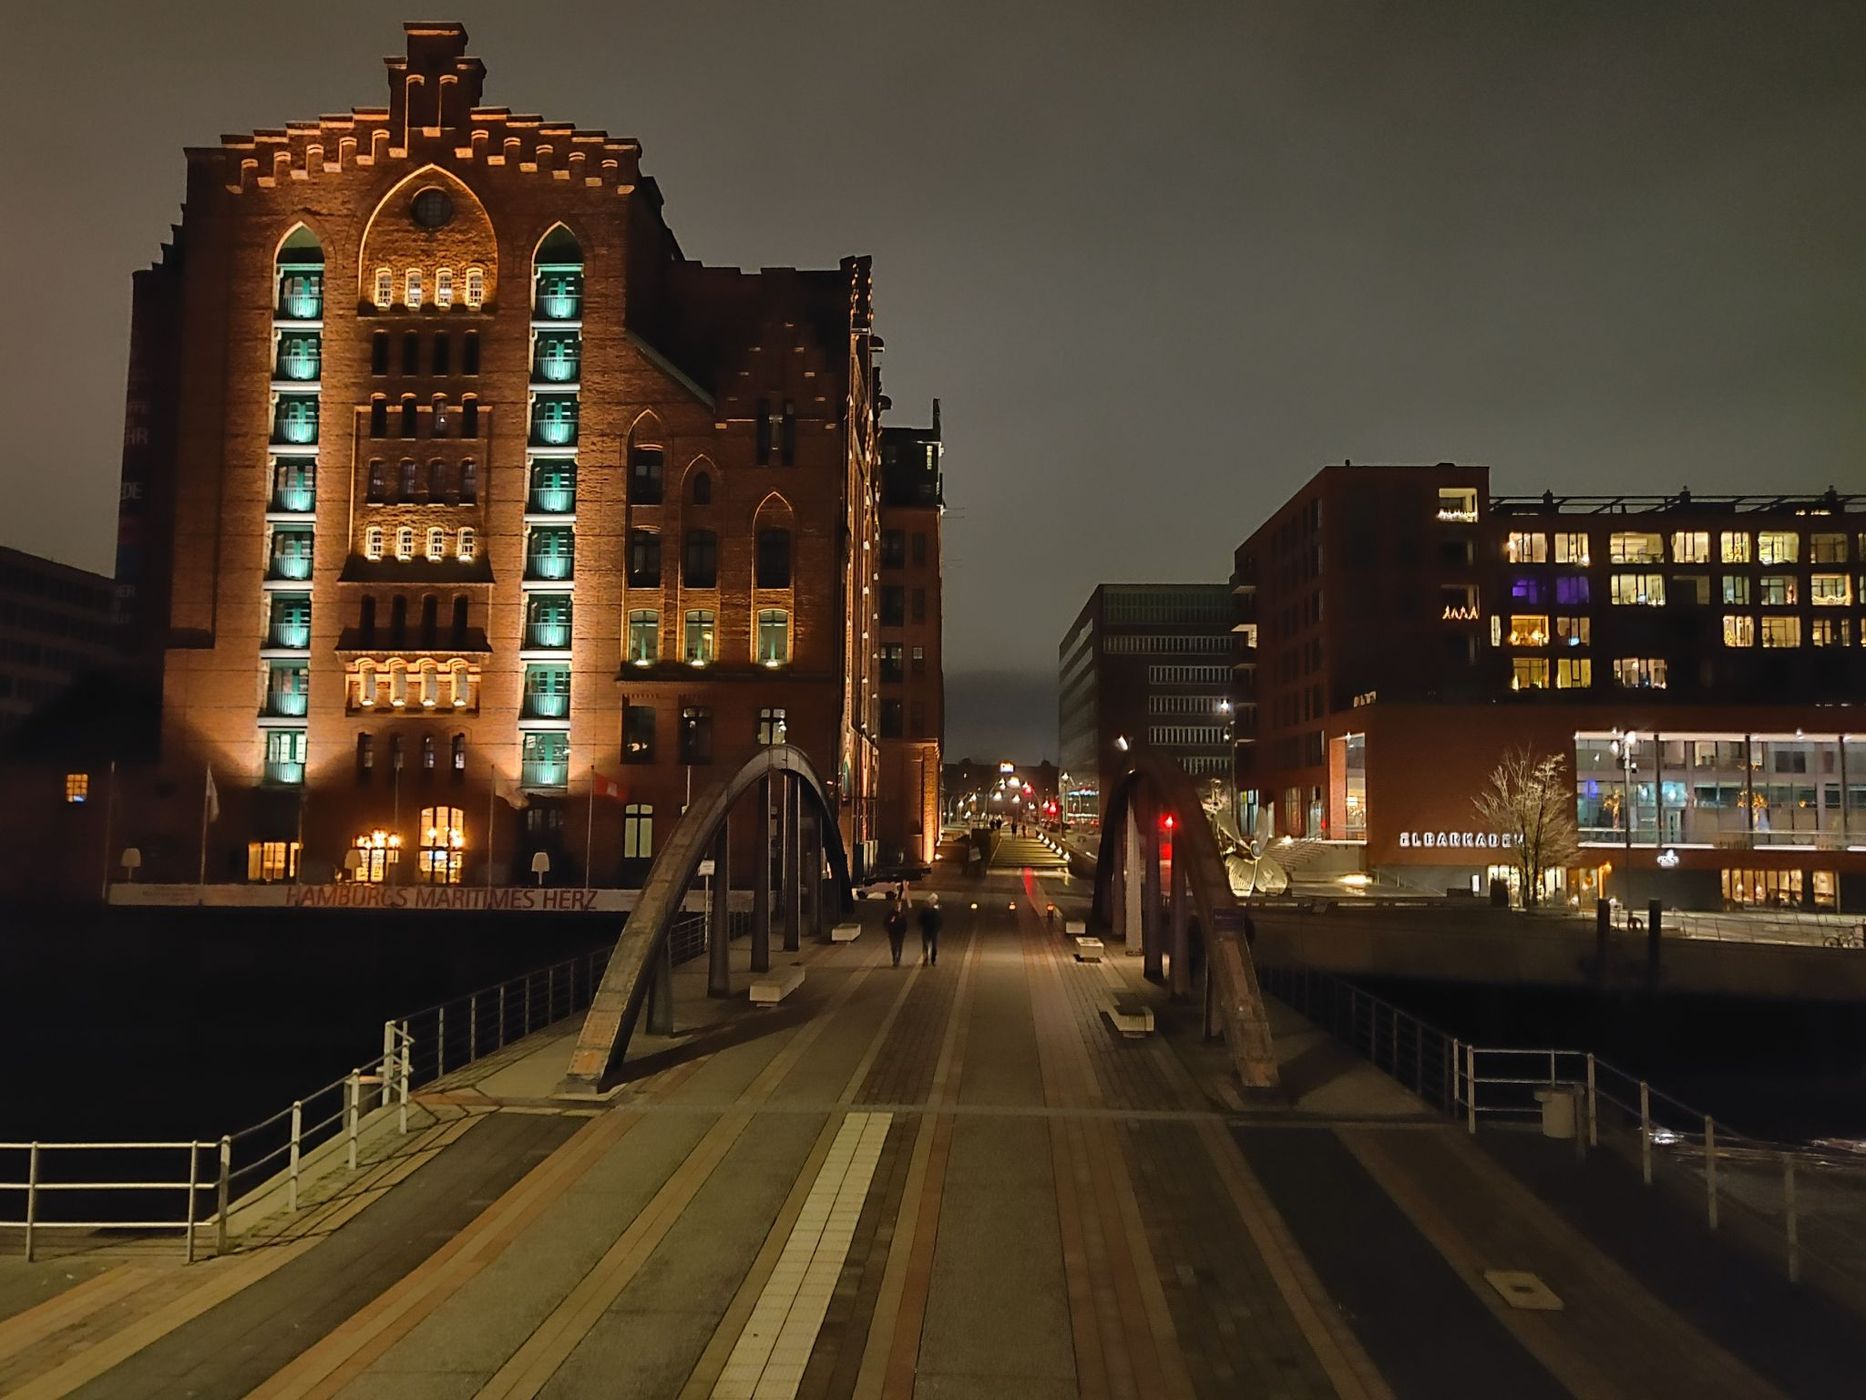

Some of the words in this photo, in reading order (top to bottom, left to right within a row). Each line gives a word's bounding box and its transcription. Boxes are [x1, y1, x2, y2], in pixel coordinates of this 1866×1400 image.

[1400, 832, 1524, 848] ELBARKADEN
[286, 886, 408, 907] HAMBURGS
[416, 888, 535, 909] MARITIMES
[543, 890, 598, 910] HERZ
